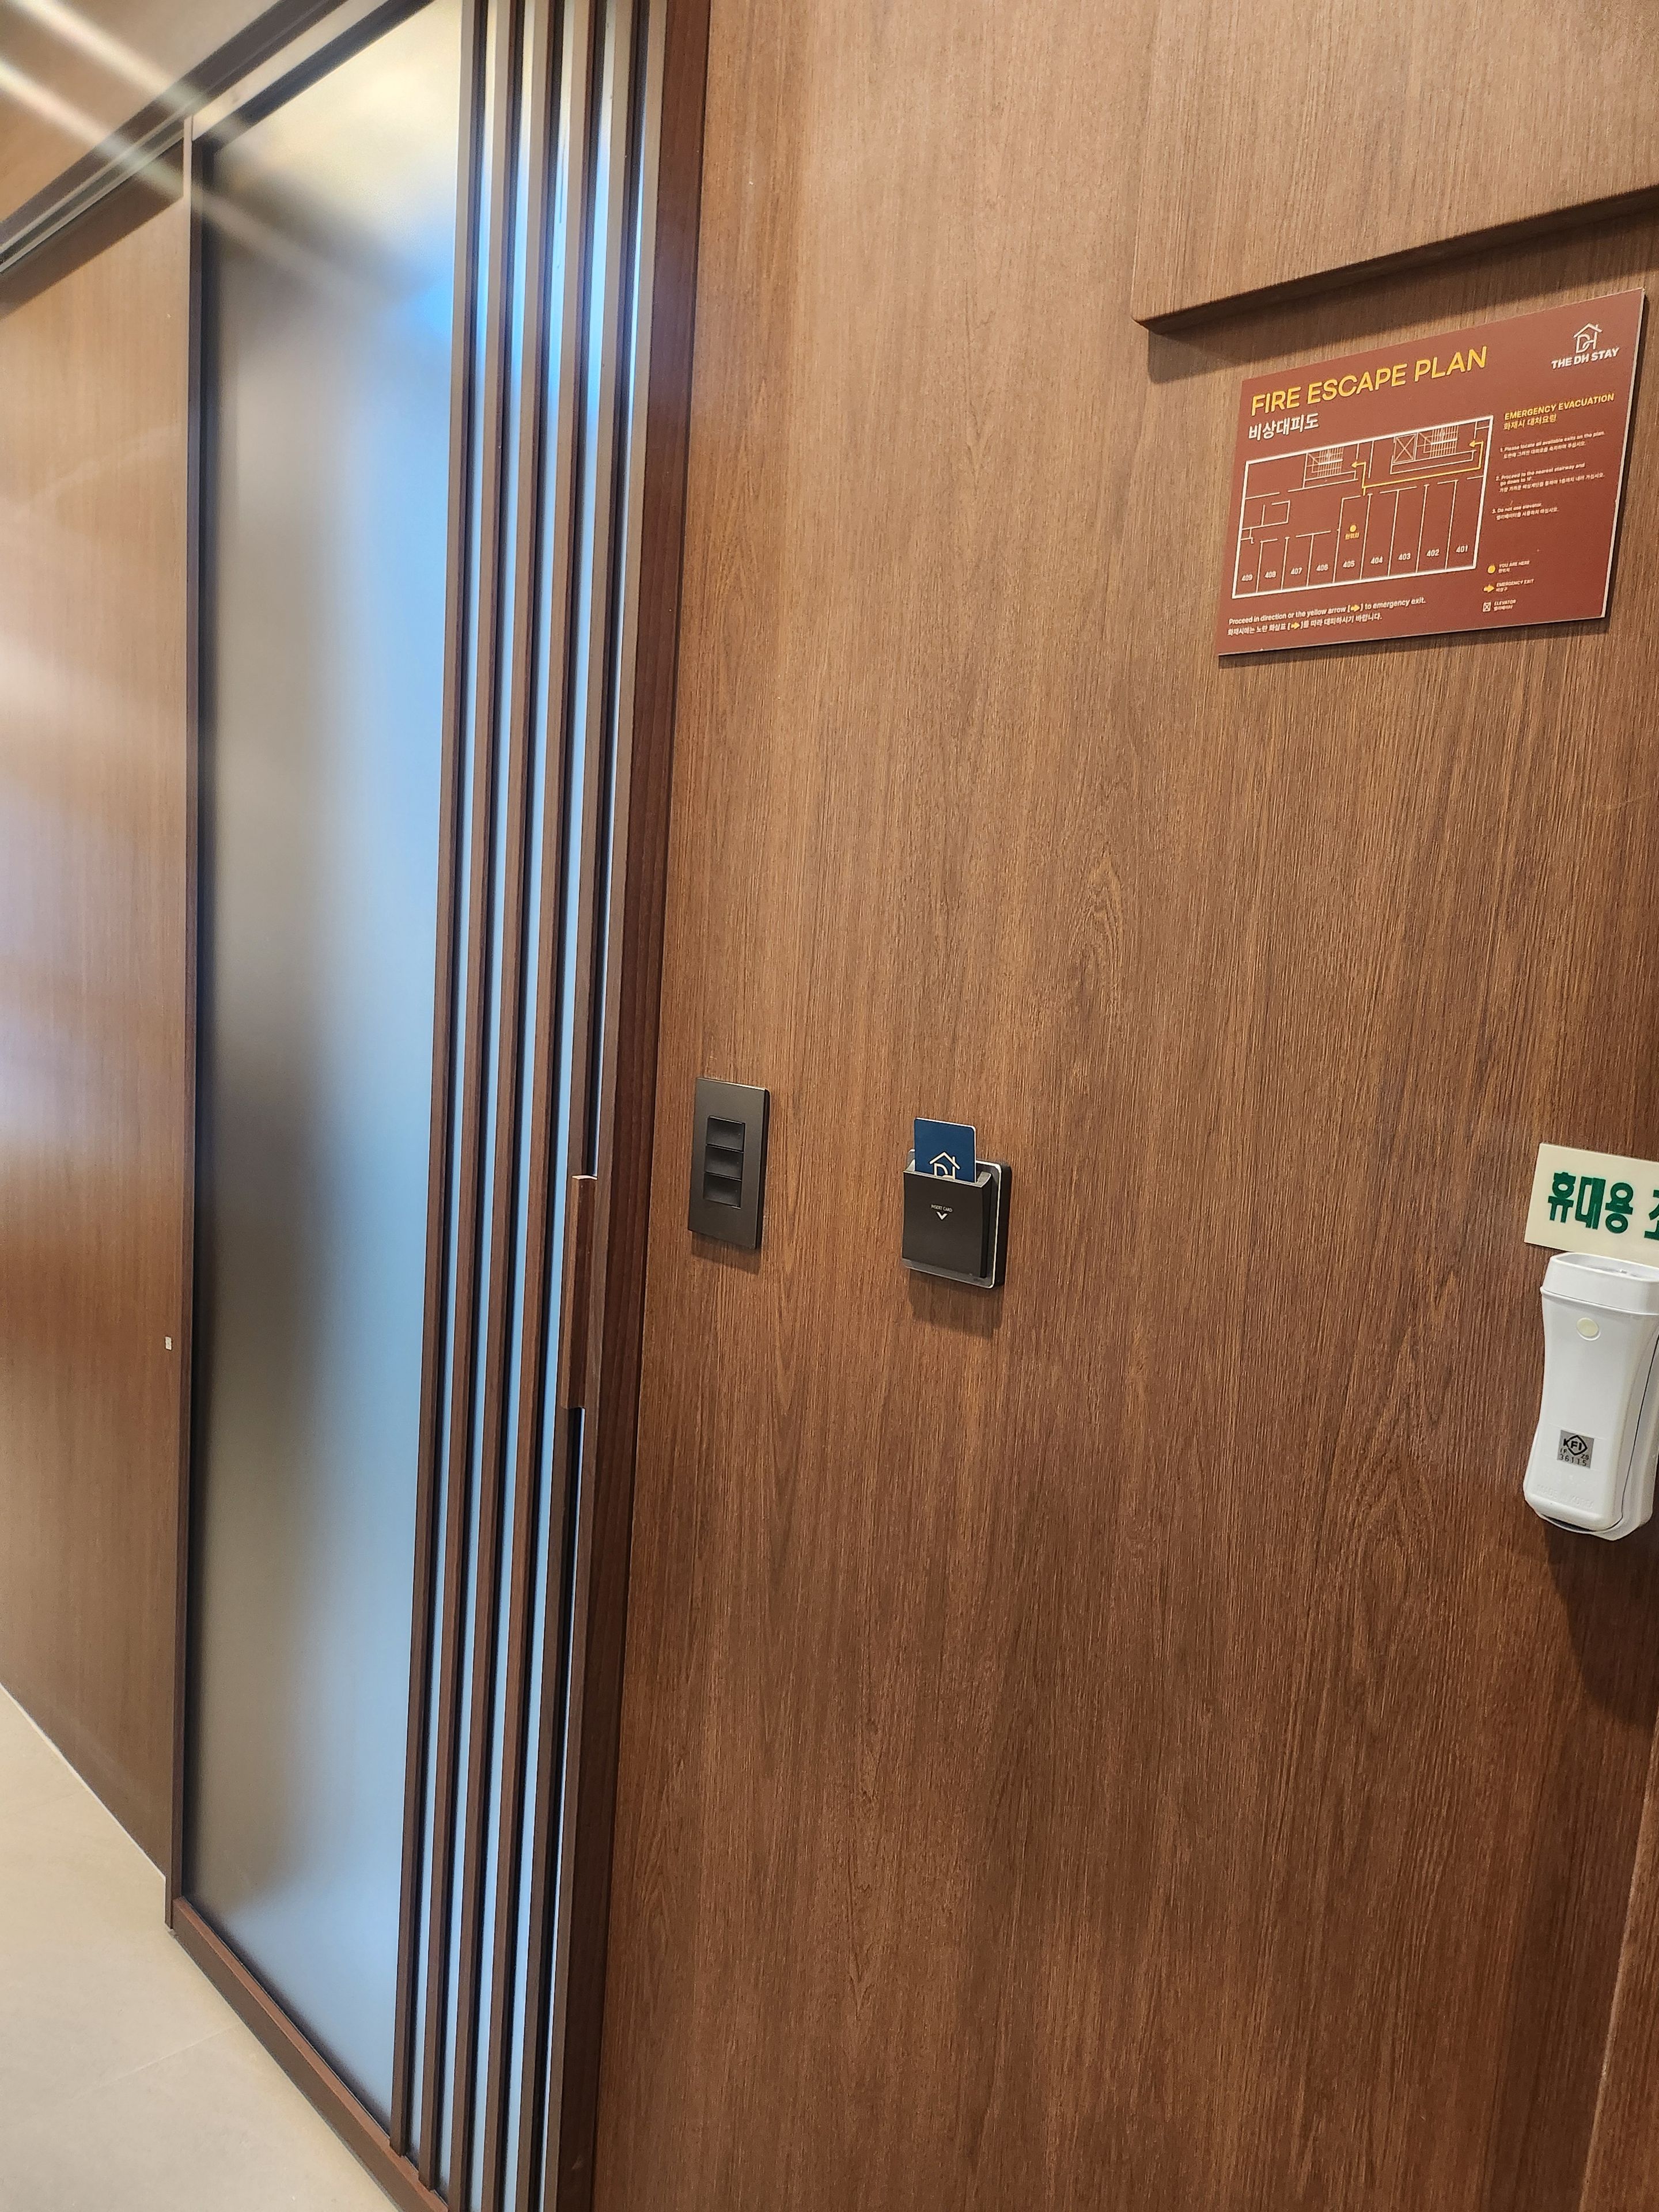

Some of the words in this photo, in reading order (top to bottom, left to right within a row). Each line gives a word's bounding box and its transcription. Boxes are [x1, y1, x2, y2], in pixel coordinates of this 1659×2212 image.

[1551, 357, 1573, 369] THE
[1574, 354, 1590, 365] DH
[1591, 347, 1619, 361] STAY
[1251, 387, 1301, 416] FIRE
[1307, 363, 1407, 404] ESCAPE
[1414, 346, 1487, 382] PLAN
[1504, 404, 1557, 421] EMERGENCY
[1558, 393, 1615, 411] EVACUATION
[1248, 412, 1319, 441] 비상대피도
[1503, 421, 1525, 430] 화재시
[1527, 414, 1556, 426] 대처요령
[1426, 549, 1440, 557] 402
[1456, 545, 1468, 553] 401
[1229, 616, 1253, 625] Proceed
[1260, 613, 1287, 622] direction
[1306, 608, 1327, 618] yellow
[1373, 599, 1410, 609] emergency
[1411, 597, 1426, 605] exit.
[1228, 627, 1255, 636] 화재시에는
[1256, 624, 1268, 632] 노란
[1269, 623, 1286, 631] 화살표
[1310, 619, 1323, 627] 따라
[1324, 614, 1354, 626] 대피하시기
[1355, 612, 1382, 622] 바랍니다.
[1548, 1172, 1634, 1234] 휴대용
[1563, 1438, 1582, 1450] KFI
[1560, 1453, 1586, 1467] 36115
